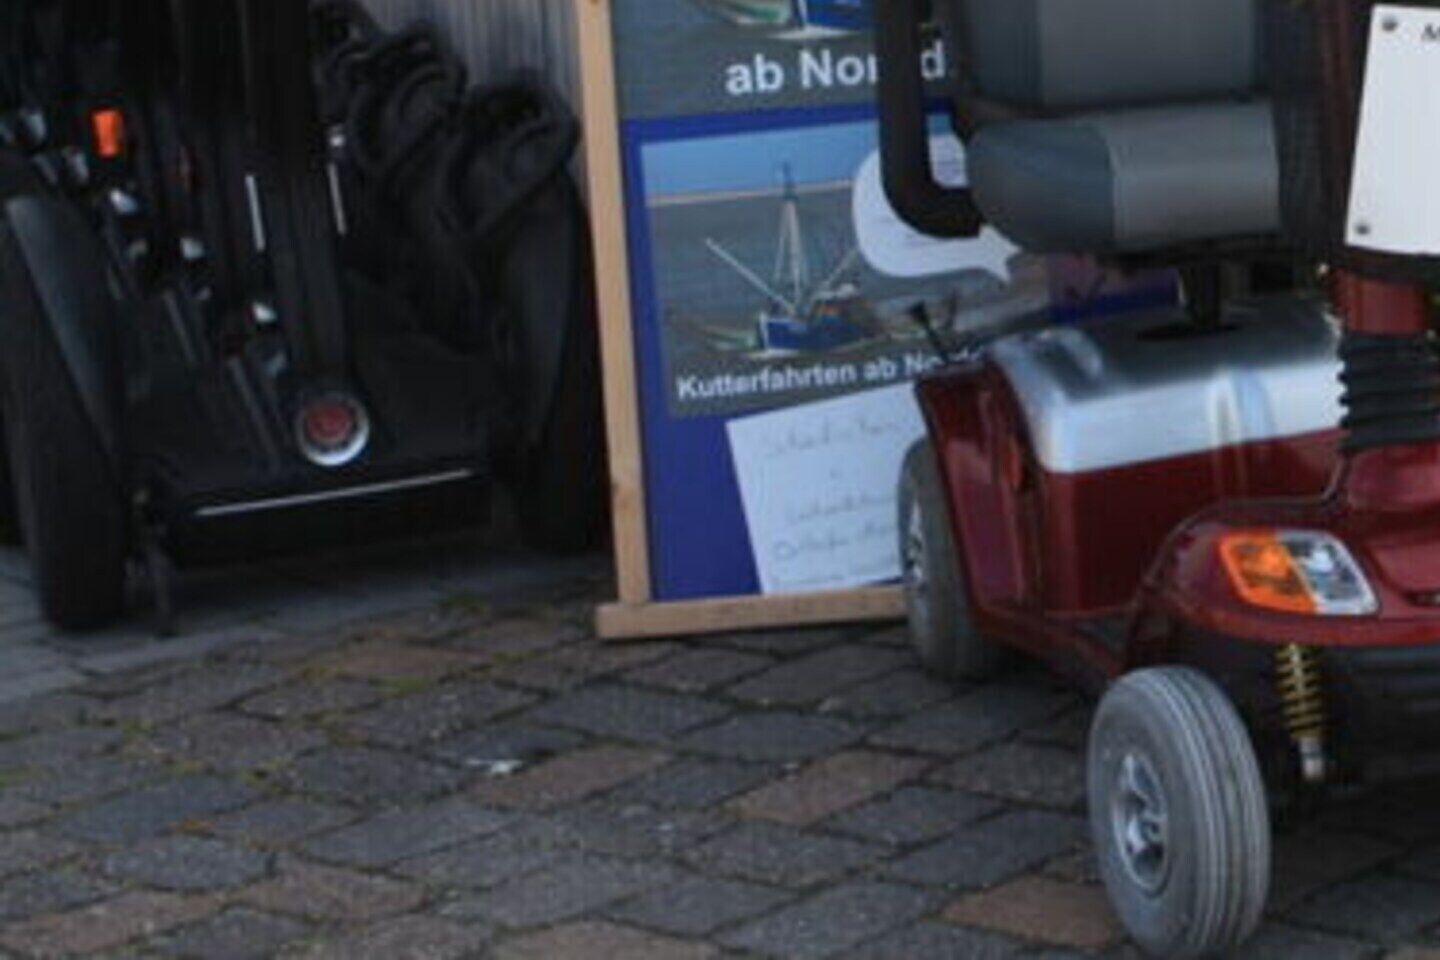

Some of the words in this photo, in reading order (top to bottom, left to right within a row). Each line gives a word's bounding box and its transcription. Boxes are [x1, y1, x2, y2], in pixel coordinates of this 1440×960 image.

[725, 53, 785, 96] ab
[676, 358, 857, 400] Kutterfahrten
[864, 356, 896, 380] ab
